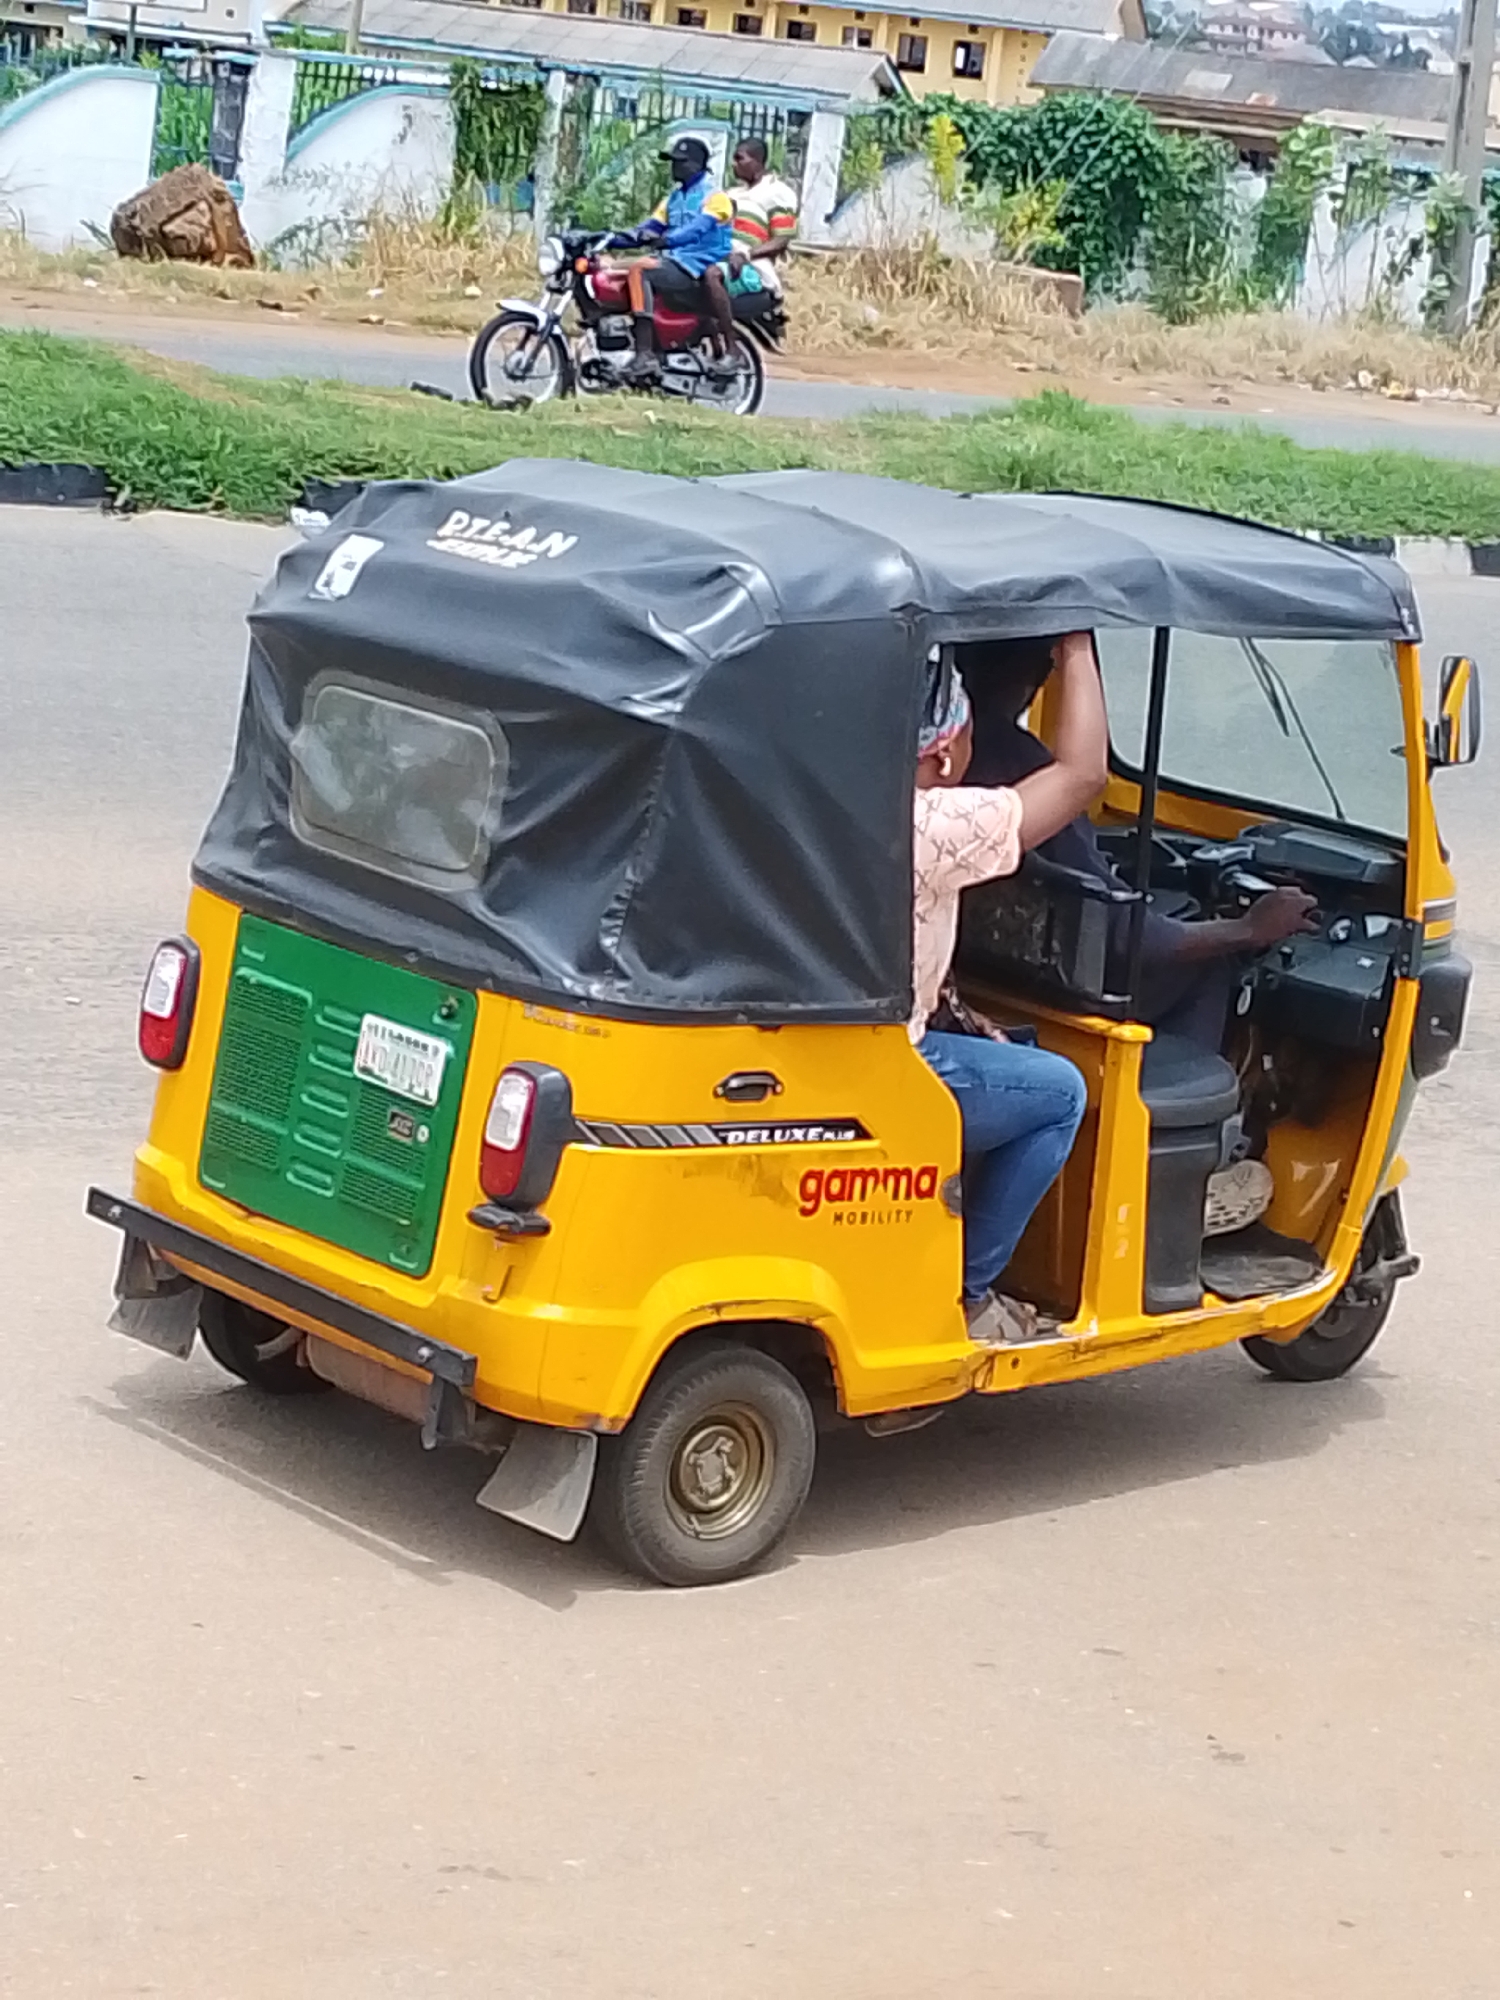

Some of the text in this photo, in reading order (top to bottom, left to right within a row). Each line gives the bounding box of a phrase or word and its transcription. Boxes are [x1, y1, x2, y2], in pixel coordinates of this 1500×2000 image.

[727, 1126, 824, 1145] DELUXE
[799, 1165, 938, 1217] gamma
[833, 1208, 914, 1227] MOBILITY
